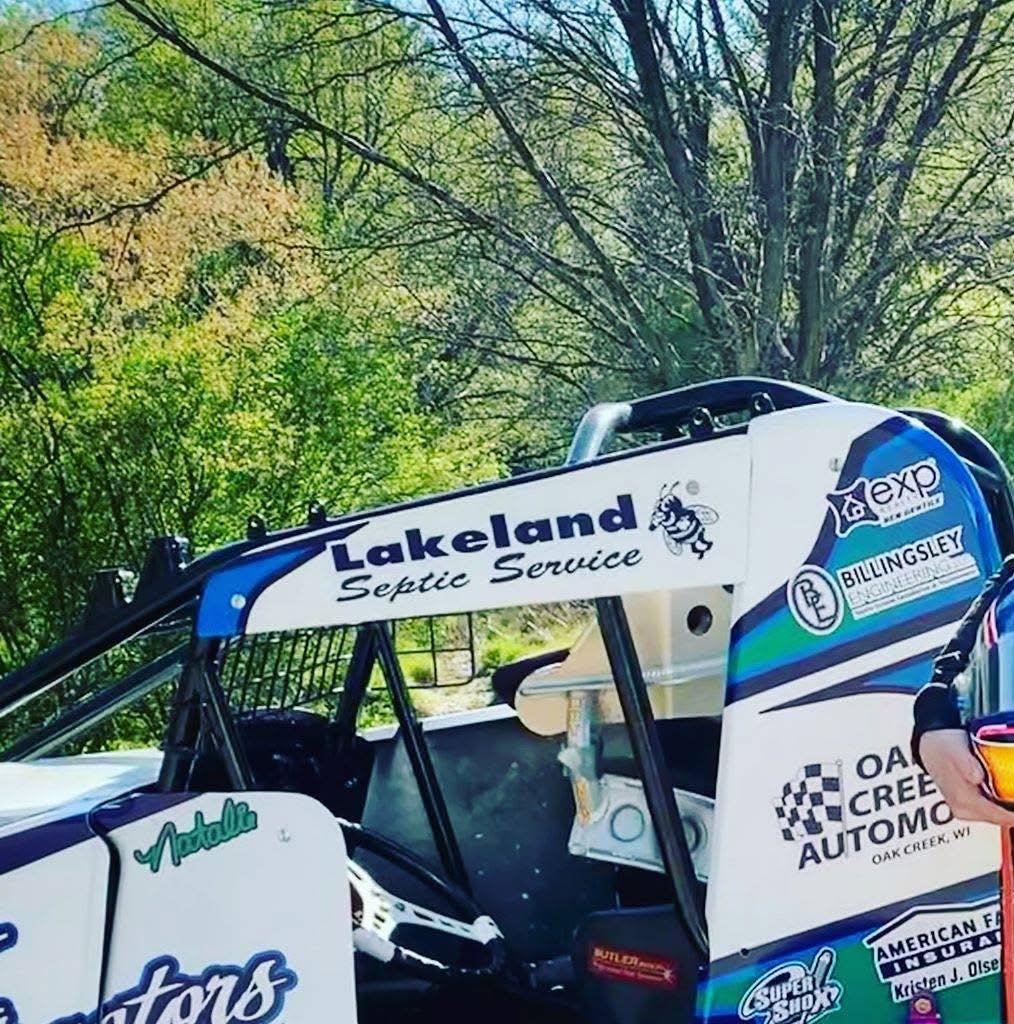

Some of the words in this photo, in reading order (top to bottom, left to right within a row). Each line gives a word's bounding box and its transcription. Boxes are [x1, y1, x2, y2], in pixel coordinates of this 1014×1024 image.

[870, 464, 938, 505] exp
[331, 494, 638, 572] Lakeland
[337, 570, 471, 602] Septic
[490, 548, 644, 584] Service
[841, 530, 963, 588] BILLINGSLEY
[856, 745, 909, 779] OA
[849, 773, 937, 816] CREE
[799, 800, 954, 870] AUTOMO
[872, 848, 901, 866] OAK
[904, 833, 950, 855] CREEK,
[953, 826, 971, 839] WI
[877, 919, 976, 962] AMERICAN
[753, 975, 814, 1010] SUPER
[894, 974, 947, 1000] Kristen
[968, 958, 999, 978] Olse
